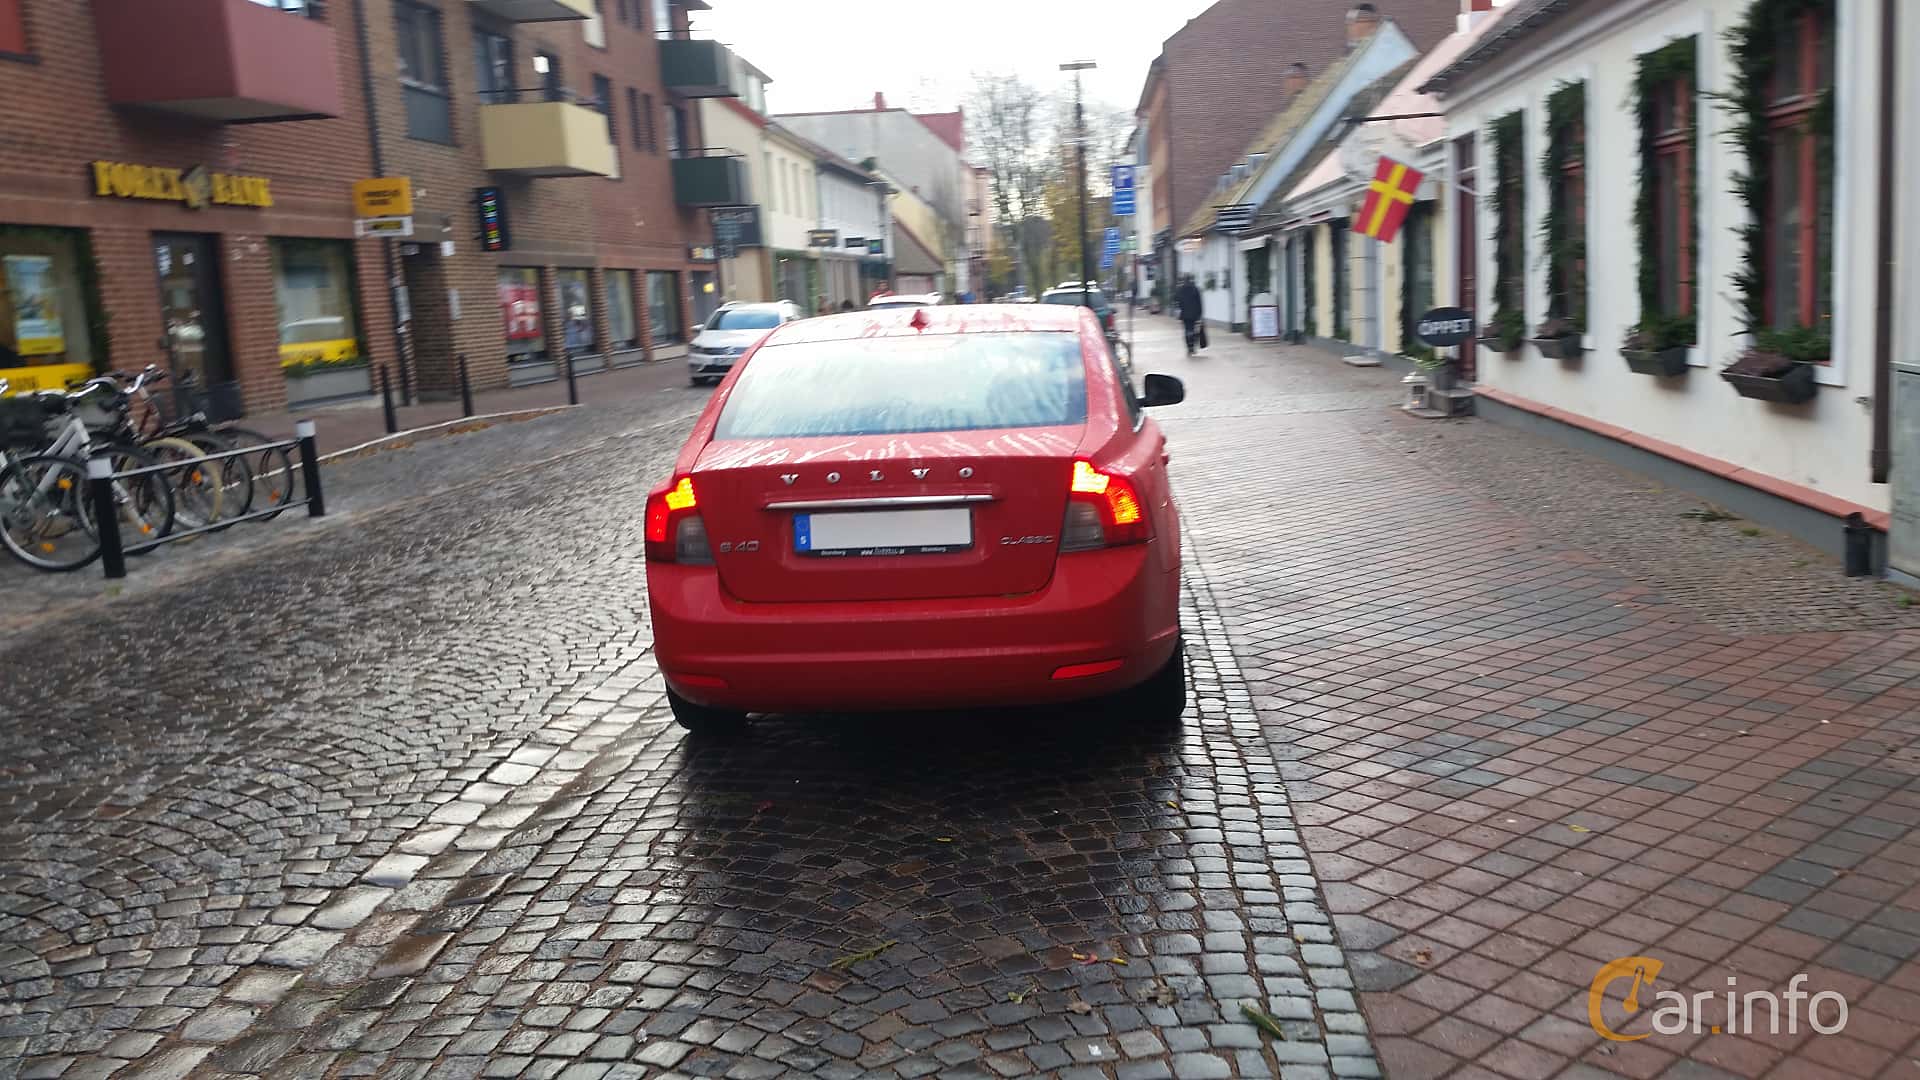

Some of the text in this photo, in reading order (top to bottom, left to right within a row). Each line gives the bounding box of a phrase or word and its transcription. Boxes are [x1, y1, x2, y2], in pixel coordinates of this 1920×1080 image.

[94, 160, 274, 207] FOREX BANK
[780, 467, 973, 485] VOLVO
